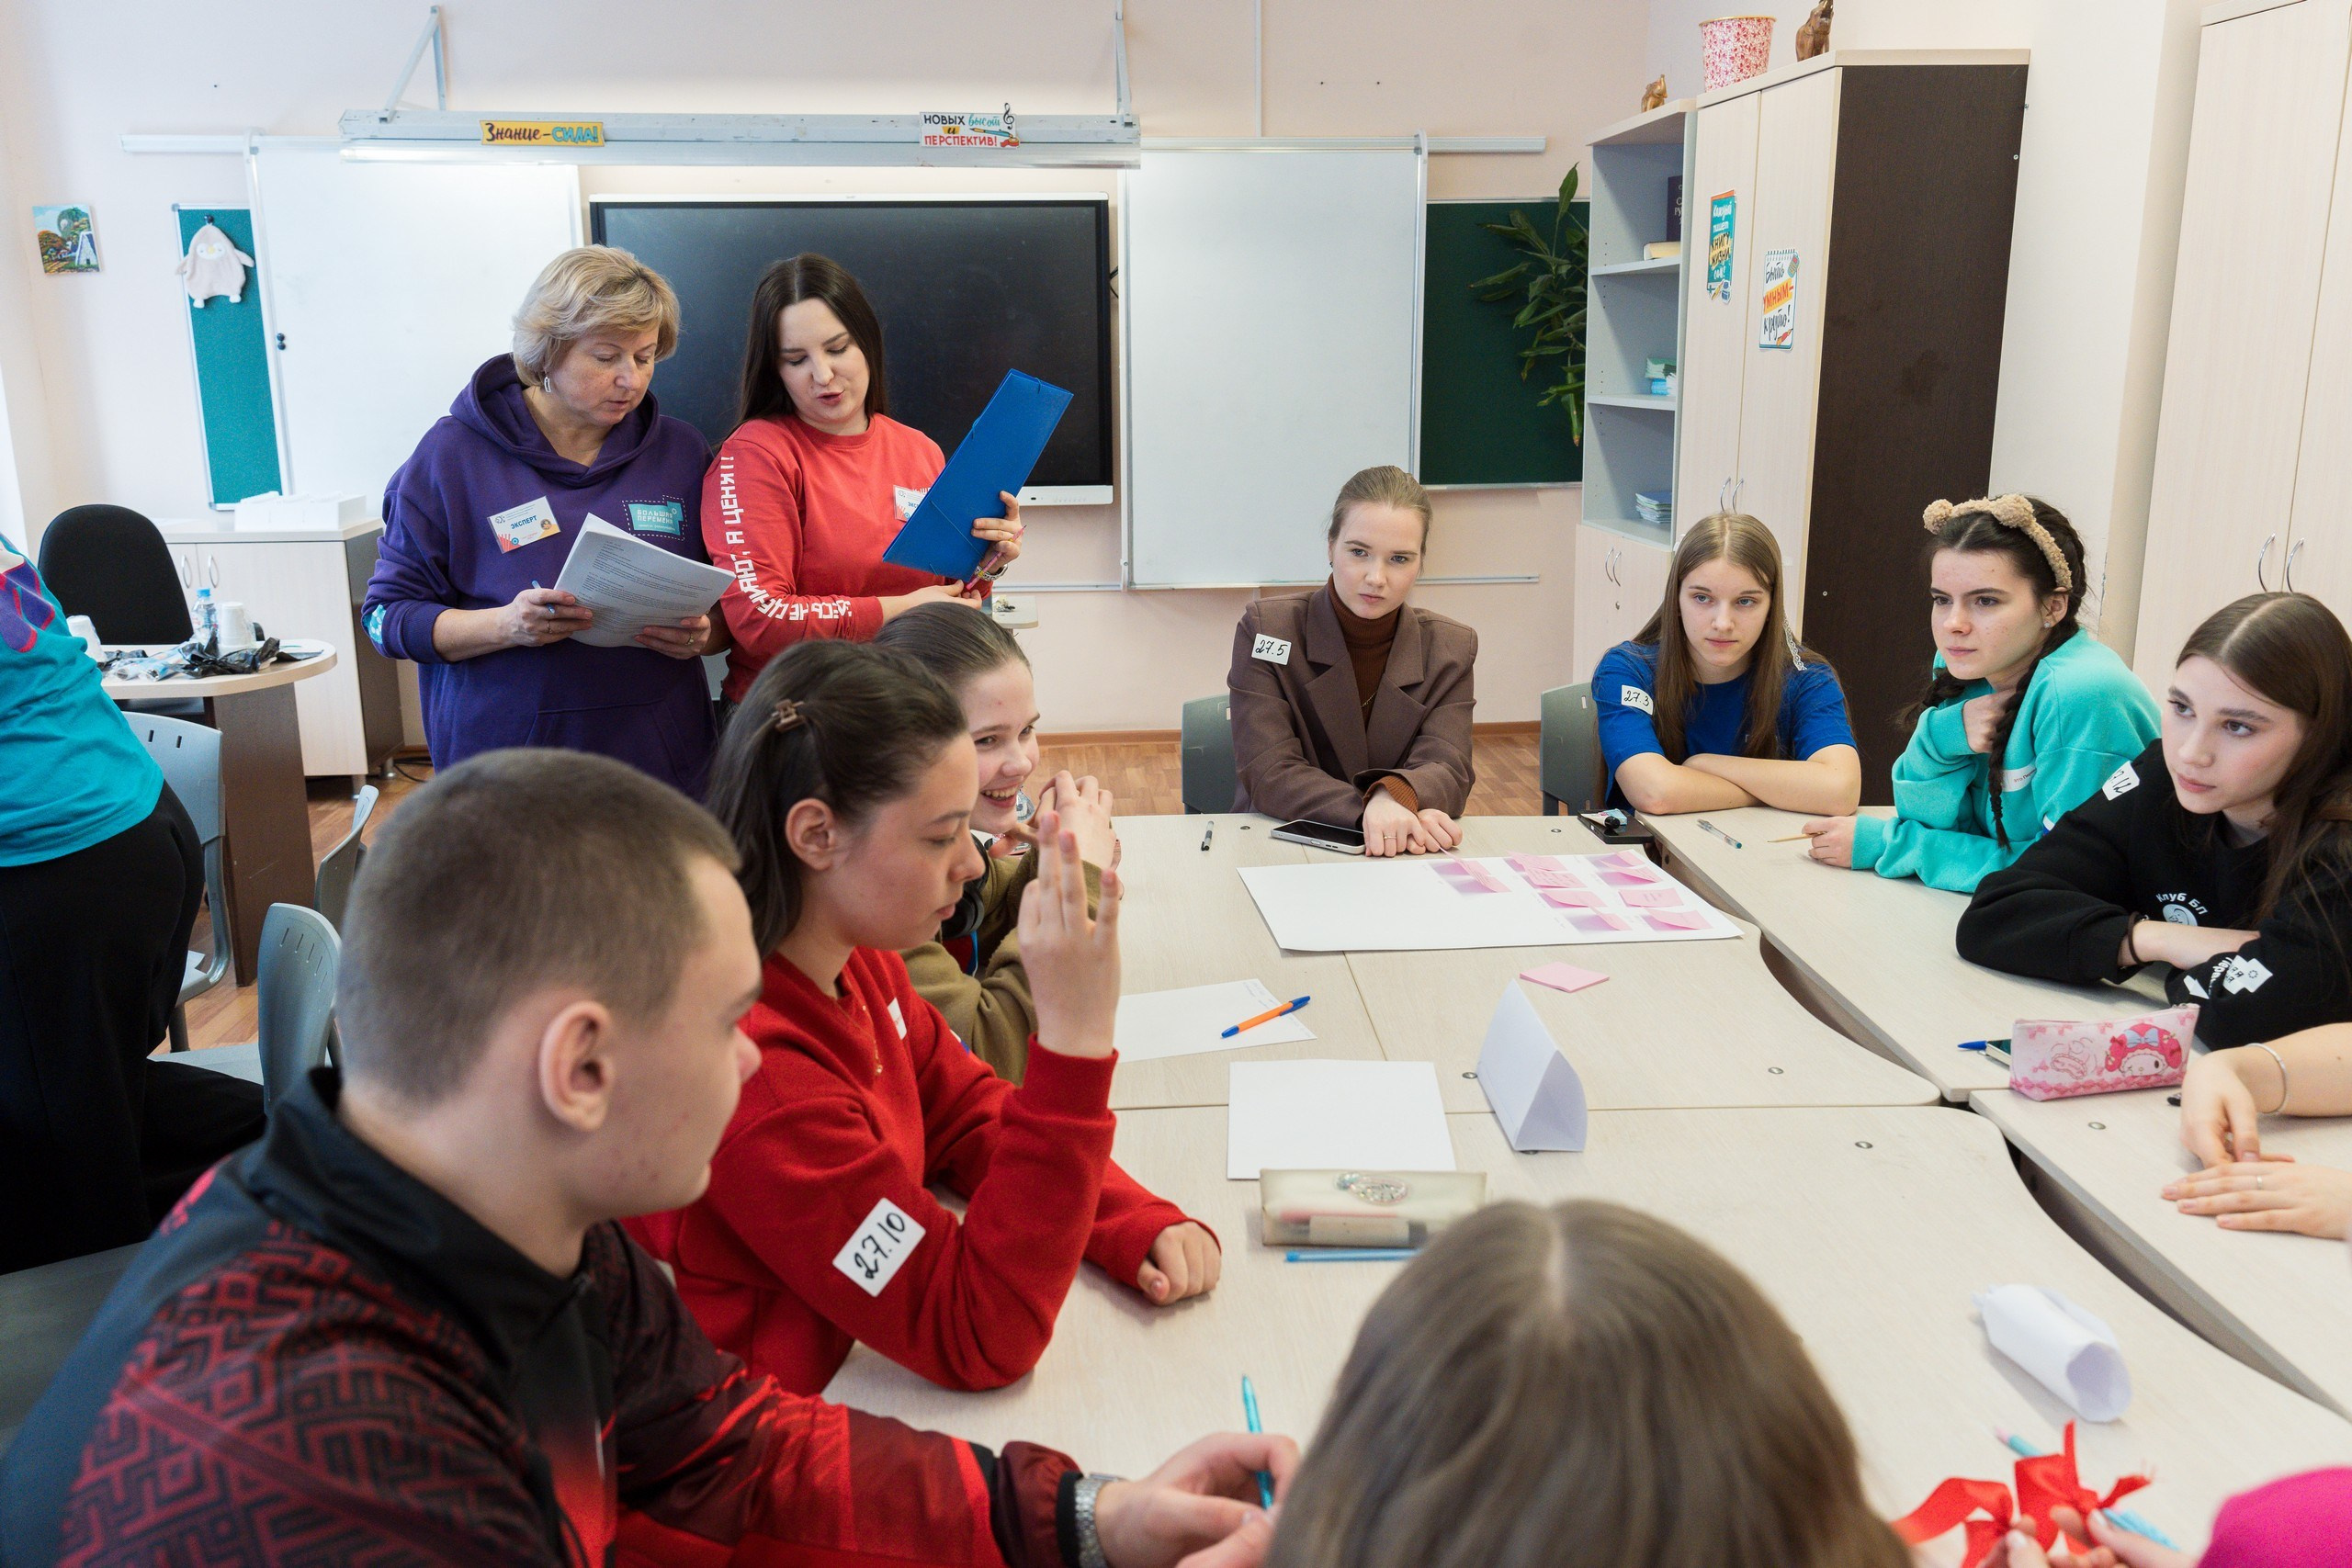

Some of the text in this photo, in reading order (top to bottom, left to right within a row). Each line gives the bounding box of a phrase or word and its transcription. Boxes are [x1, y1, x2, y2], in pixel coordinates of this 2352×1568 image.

[923, 114, 966, 125] НОВЫХ
[924, 135, 998, 146] ПЕРСПЕКТИВ!
[637, 508, 673, 518] БОЛЬШАЯ
[637, 515, 673, 525] ПЕРЕМЕНА
[510, 514, 537, 530] ЭКСПЕРТ
[726, 531, 745, 545] А
[1255, 639, 1288, 656] 27.5
[1623, 690, 1650, 706] 27.3
[2155, 892, 2209, 915] Клуб БП
[854, 1212, 905, 1280] 27.10
